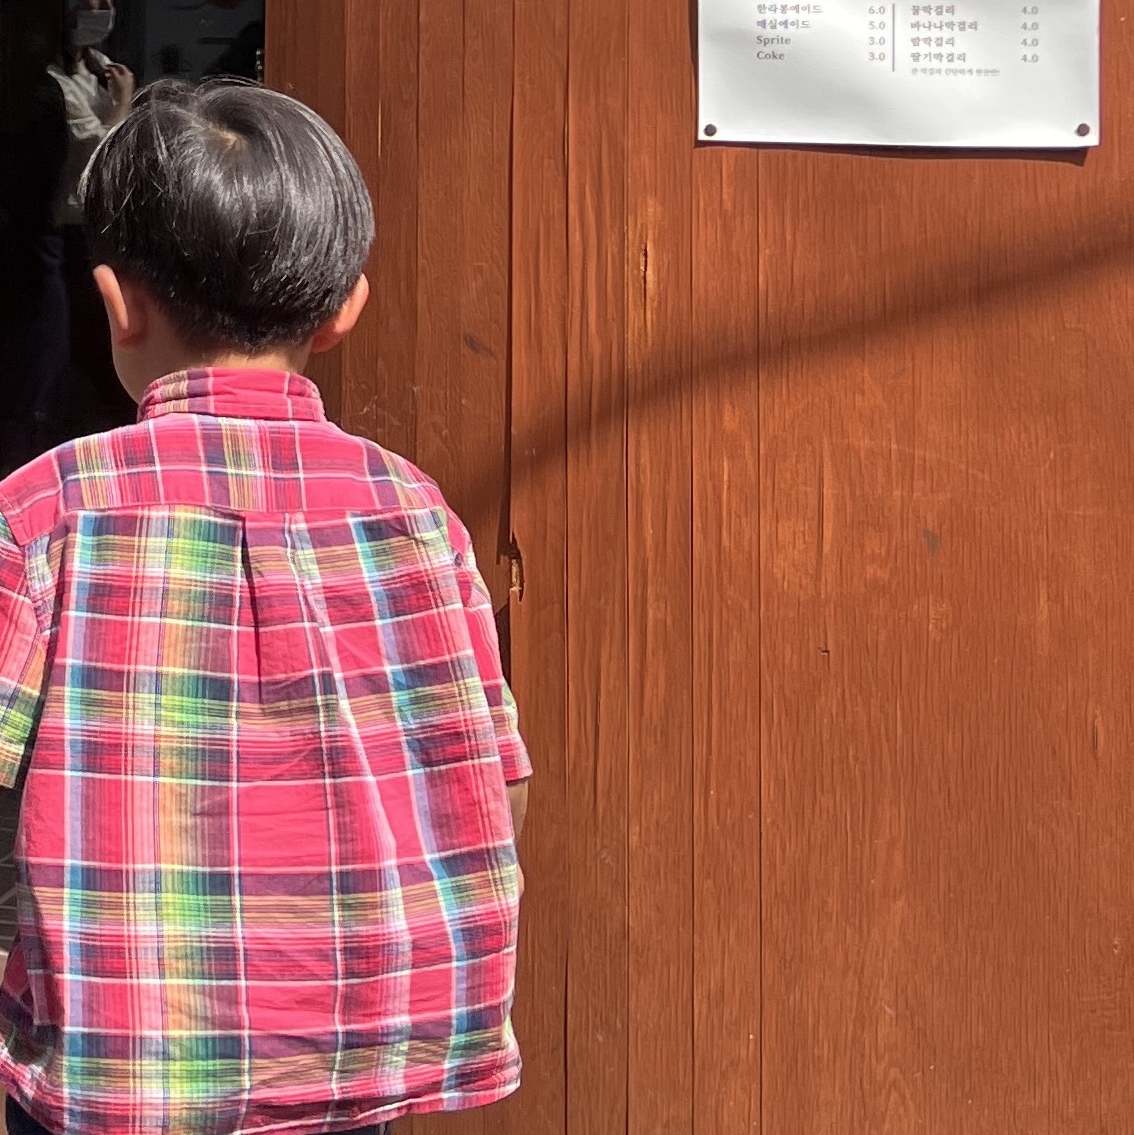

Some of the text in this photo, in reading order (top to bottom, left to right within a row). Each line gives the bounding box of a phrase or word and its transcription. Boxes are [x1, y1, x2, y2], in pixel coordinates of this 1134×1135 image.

[757, 4, 822, 14] 한라봉에이드
[869, 6, 885, 14] 6.0
[1021, 6, 1039, 15] 4.0
[756, 19, 811, 30] 매실에이드
[869, 21, 885, 30] 5.0
[911, 21, 978, 32] 바나나막걸리
[1021, 22, 1039, 30] 4.0
[755, 34, 791, 47] Sprite
[869, 37, 885, 45] 3.0
[1021, 38, 1039, 47] 4.0
[757, 51, 785, 60] Coke
[869, 52, 885, 61] 3.0
[910, 52, 966, 63] 딸기막걸리
[1021, 54, 1039, 62] 4.0
